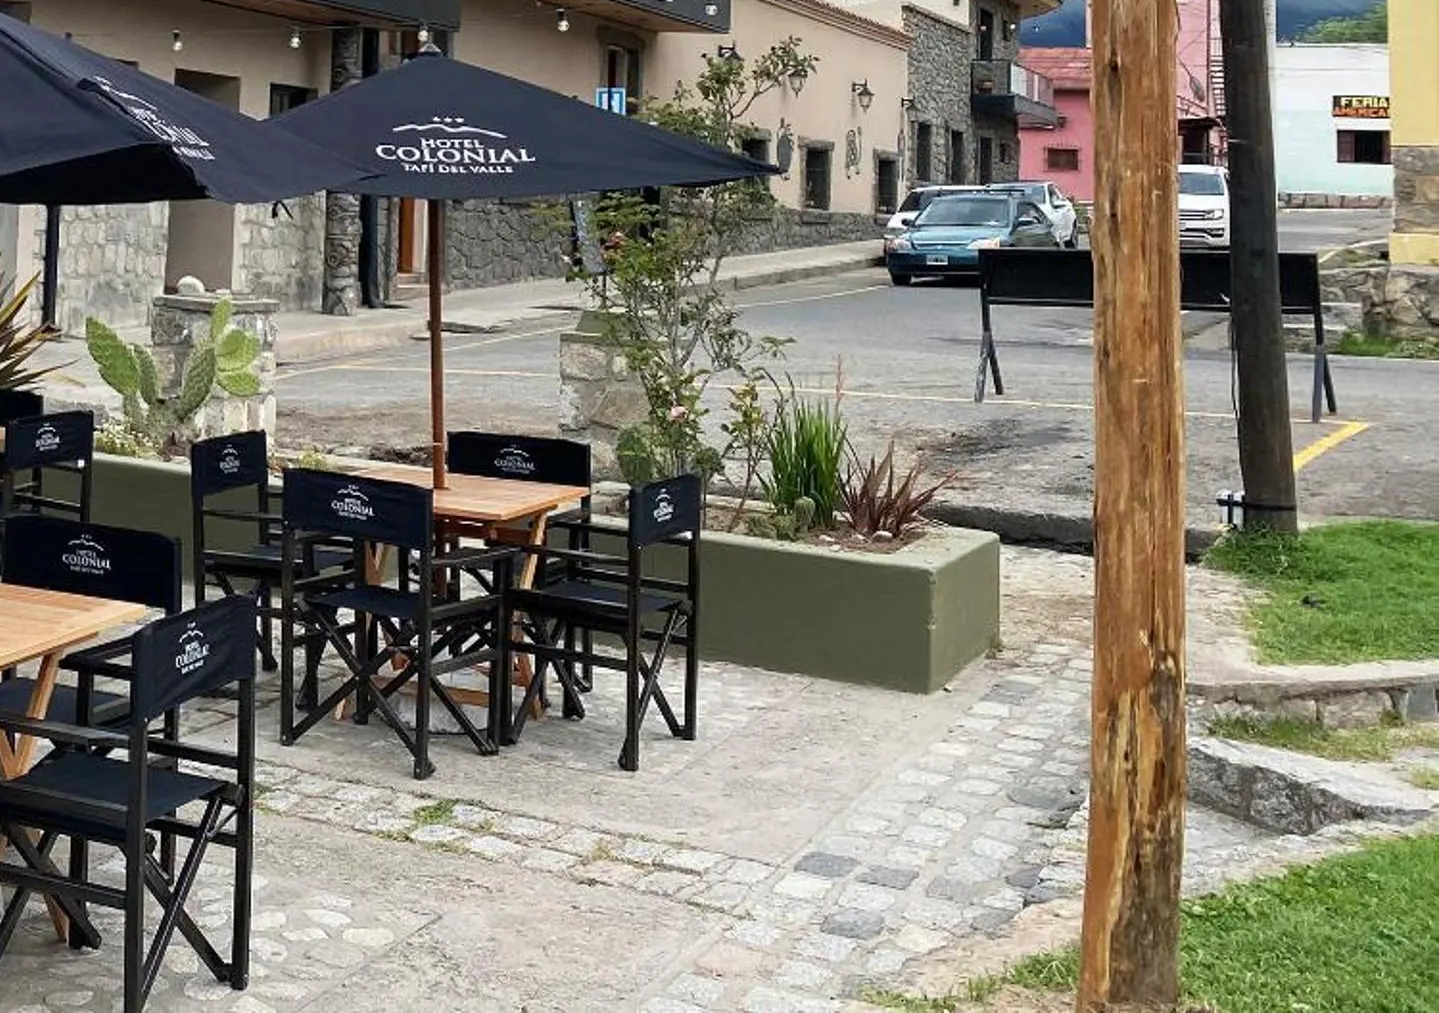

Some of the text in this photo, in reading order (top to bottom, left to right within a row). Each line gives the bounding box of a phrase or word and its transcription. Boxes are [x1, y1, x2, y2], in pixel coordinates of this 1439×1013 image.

[1340, 97, 1389, 108] FERIA
[420, 138, 485, 149] HOTEL
[375, 144, 537, 164] COLONIAL
[438, 164, 469, 173] DEL
[469, 164, 515, 173] VALLE
